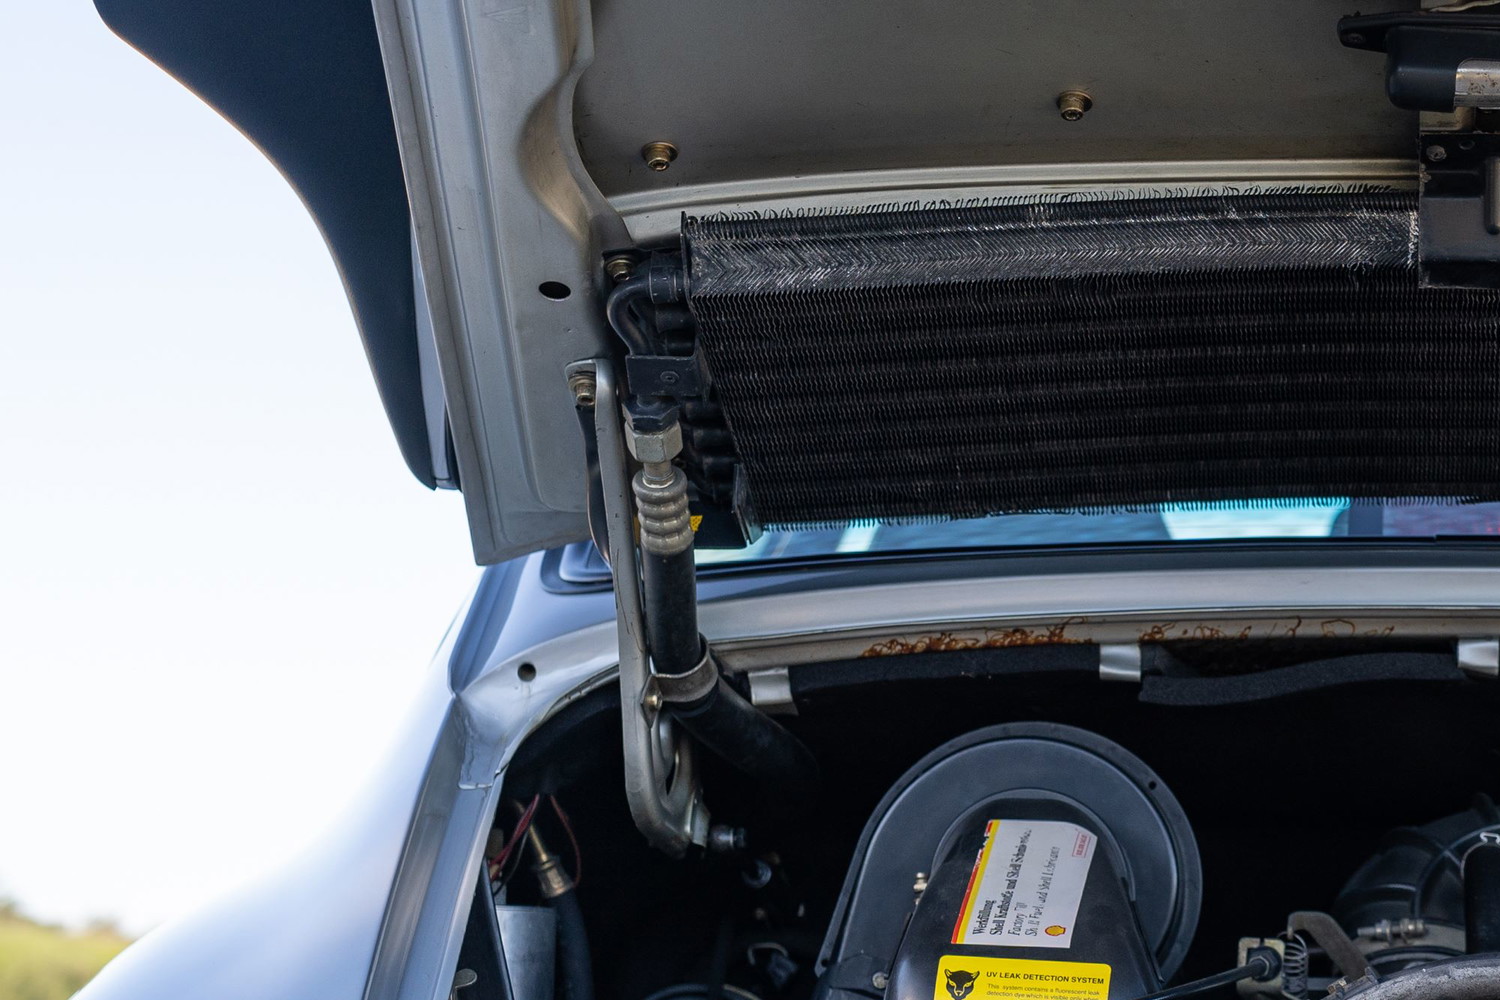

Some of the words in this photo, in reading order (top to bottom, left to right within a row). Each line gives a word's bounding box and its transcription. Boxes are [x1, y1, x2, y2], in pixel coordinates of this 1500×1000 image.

[990, 919, 1005, 936] Shell
[1007, 863, 1022, 878] Shell
[1023, 974, 1069, 982] DETECTION
[1072, 976, 1104, 984] SYSTEM
[1055, 987, 1087, 995] fluorescent
